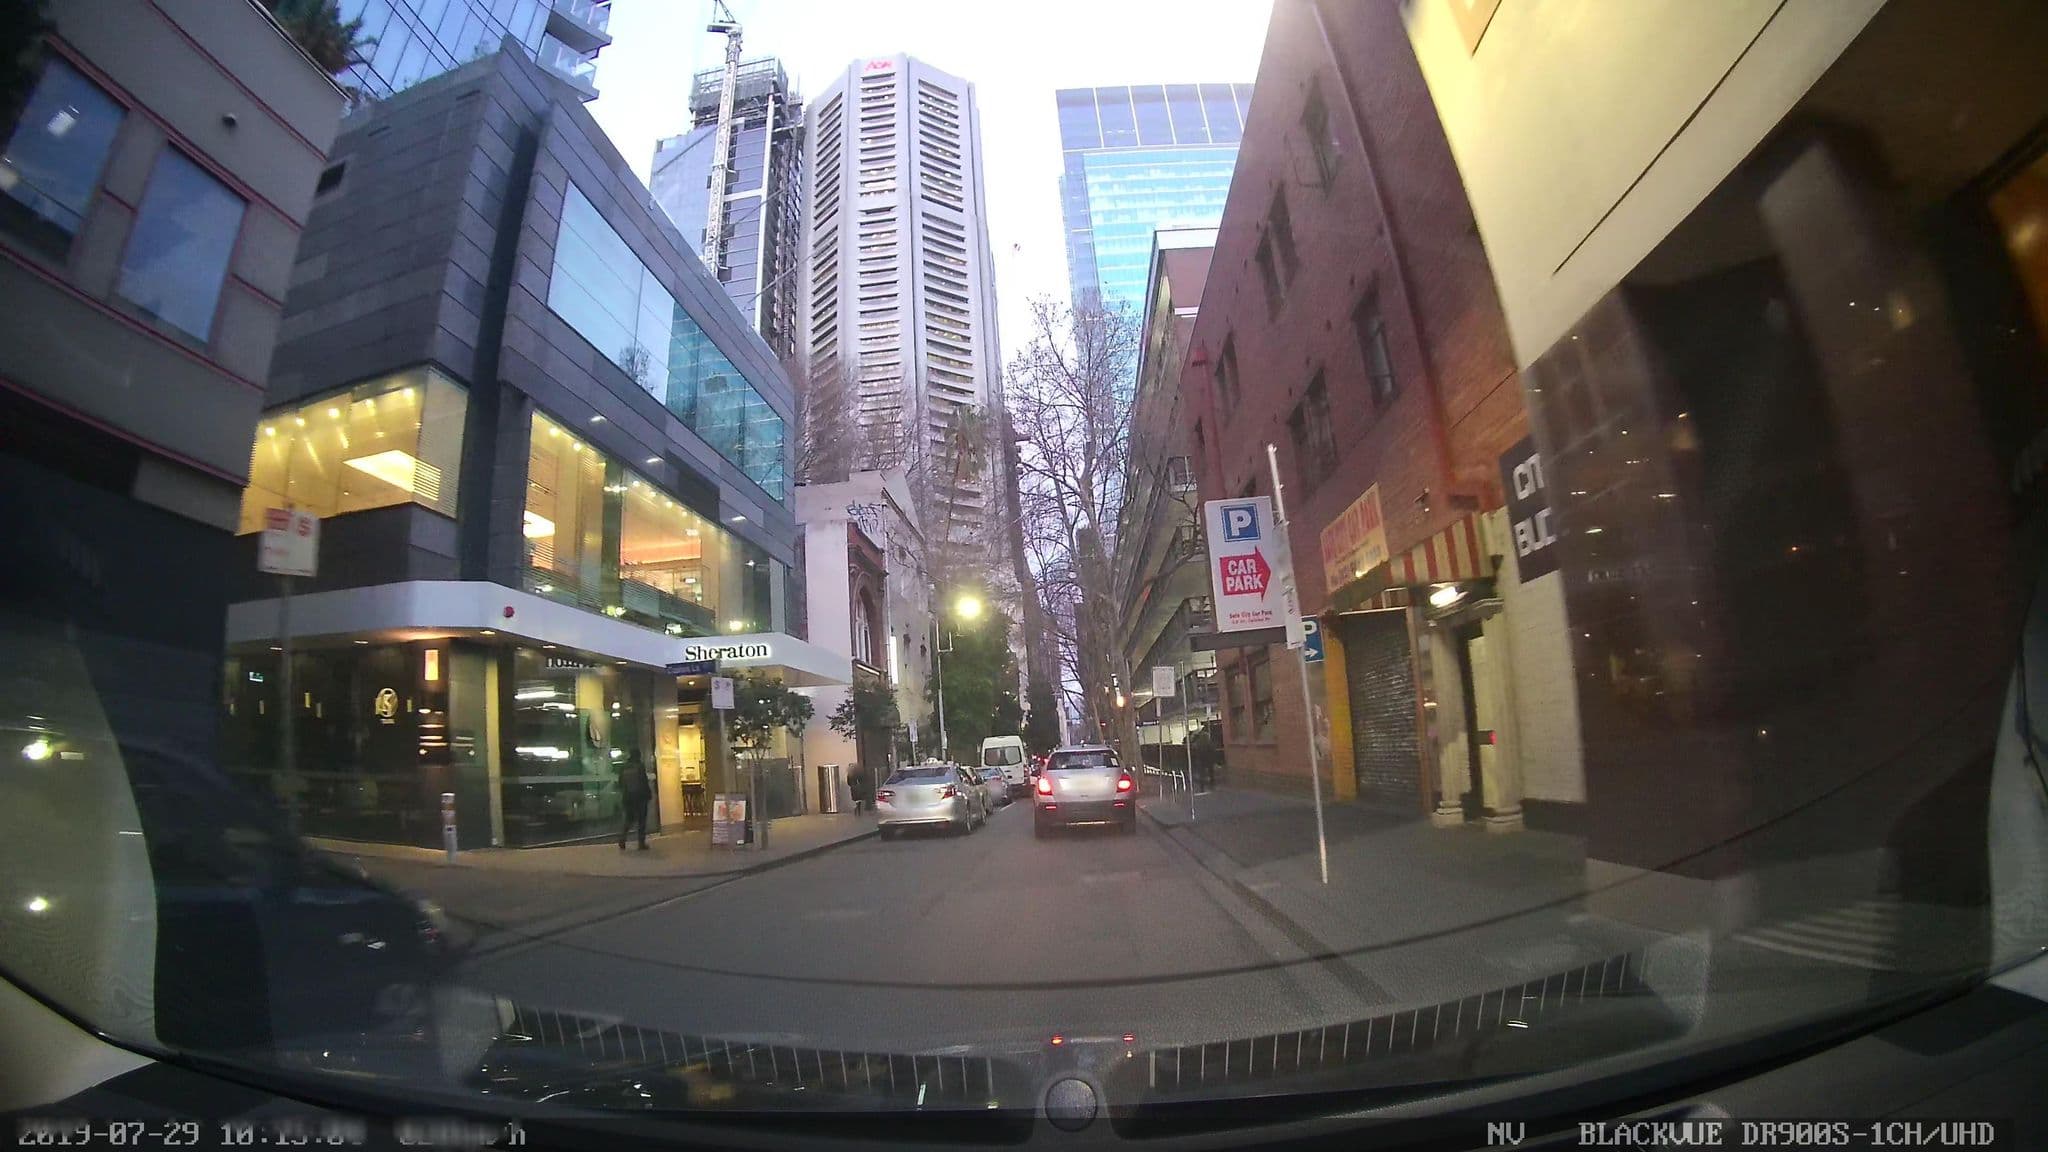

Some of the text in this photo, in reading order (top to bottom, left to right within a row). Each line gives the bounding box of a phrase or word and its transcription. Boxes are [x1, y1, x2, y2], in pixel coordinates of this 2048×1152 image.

[1228, 558, 1257, 575] CAR
[1226, 574, 1264, 592] PARK
[685, 643, 768, 661] Sheraton
